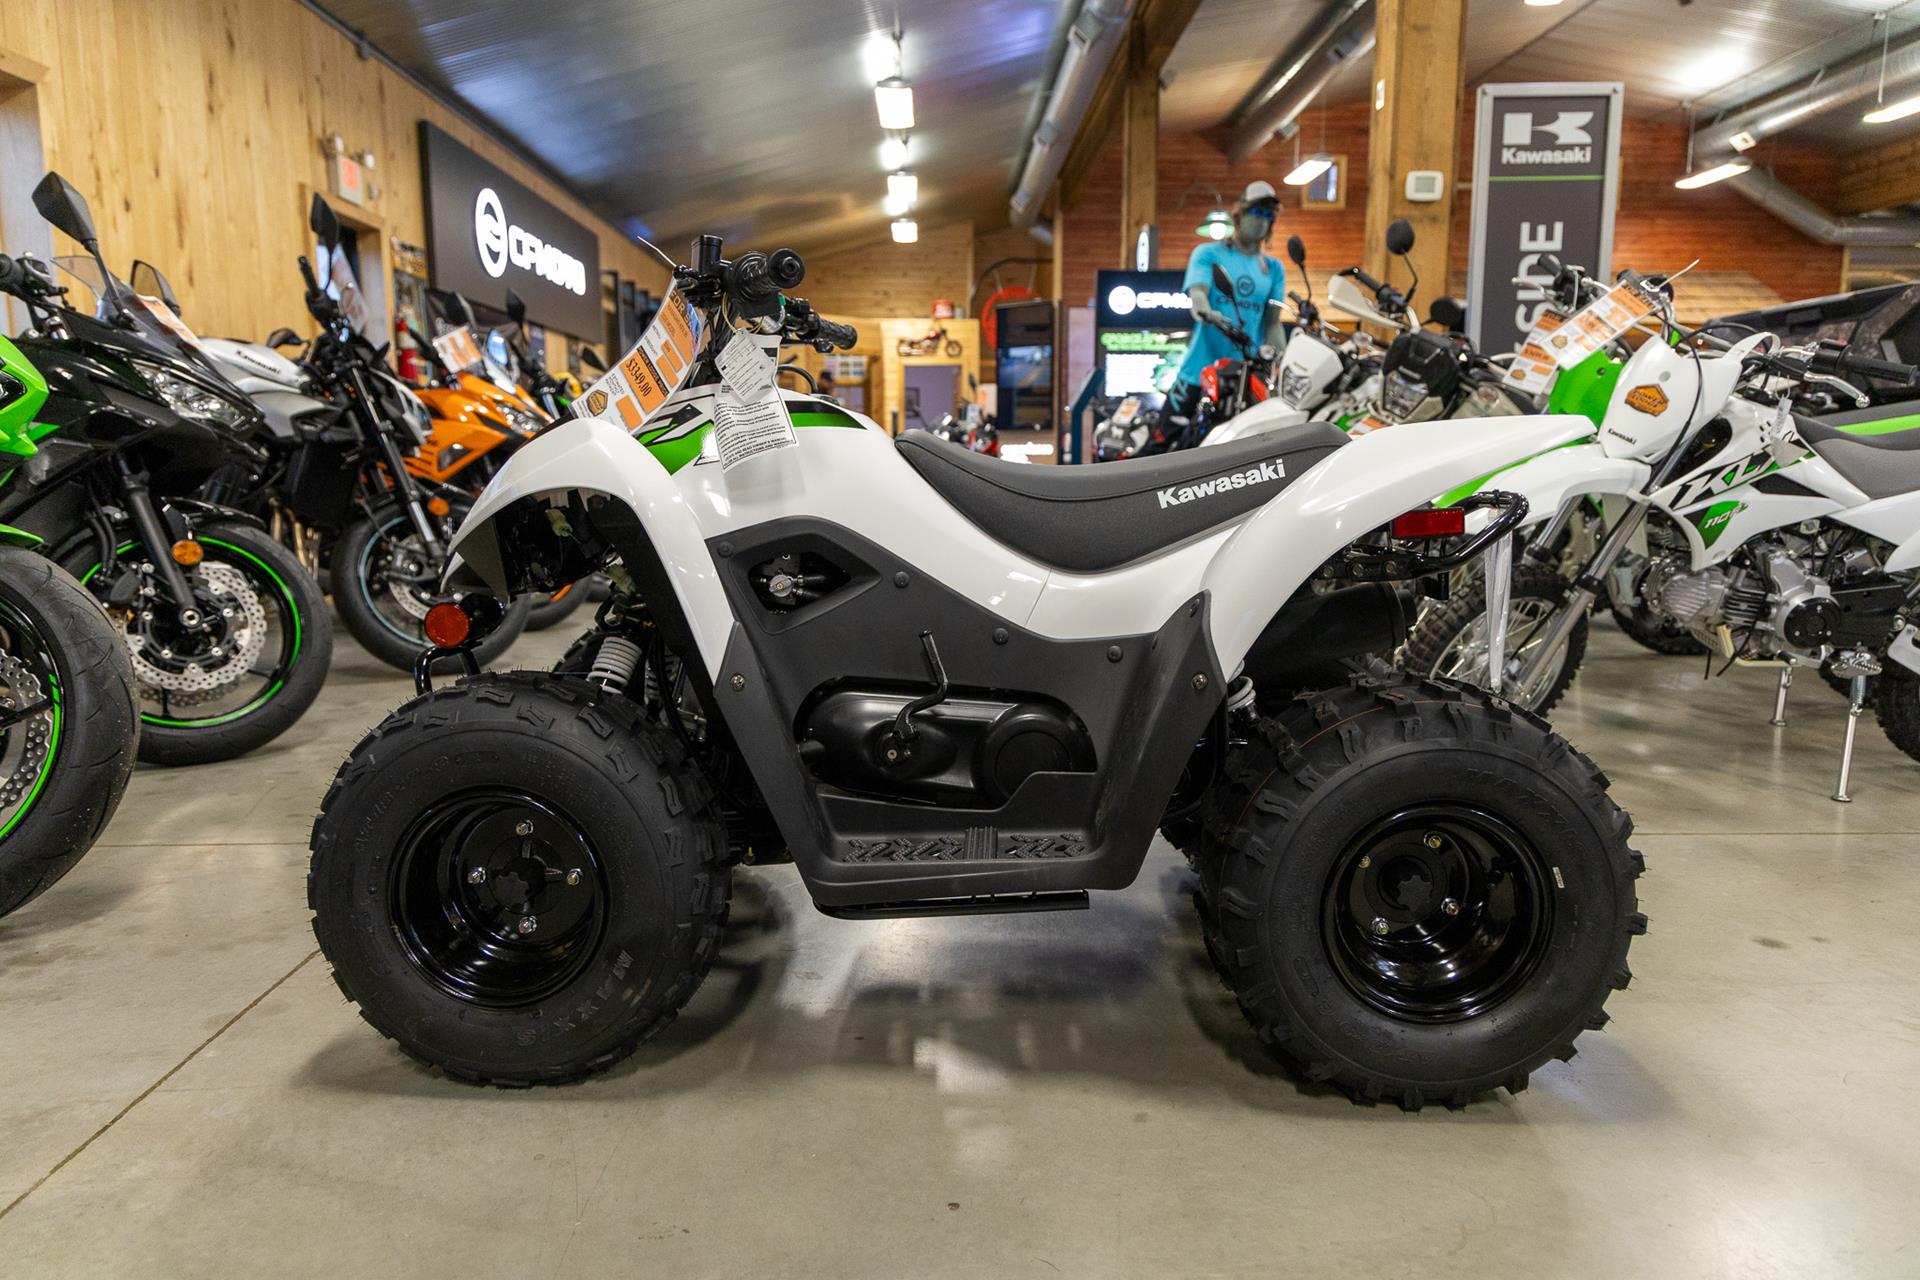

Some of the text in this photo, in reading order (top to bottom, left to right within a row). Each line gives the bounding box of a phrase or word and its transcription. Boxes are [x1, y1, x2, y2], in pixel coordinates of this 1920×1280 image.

[1502, 147, 1592, 165] Kawasaki
[1515, 221, 1563, 332] SIDE
[670, 291, 686, 311] FOR
[626, 358, 652, 397] $3349.00
[1607, 428, 1637, 444] Kawasaki
[1157, 459, 1286, 509] Kawasaki
[516, 949, 634, 1047] MAXXS
